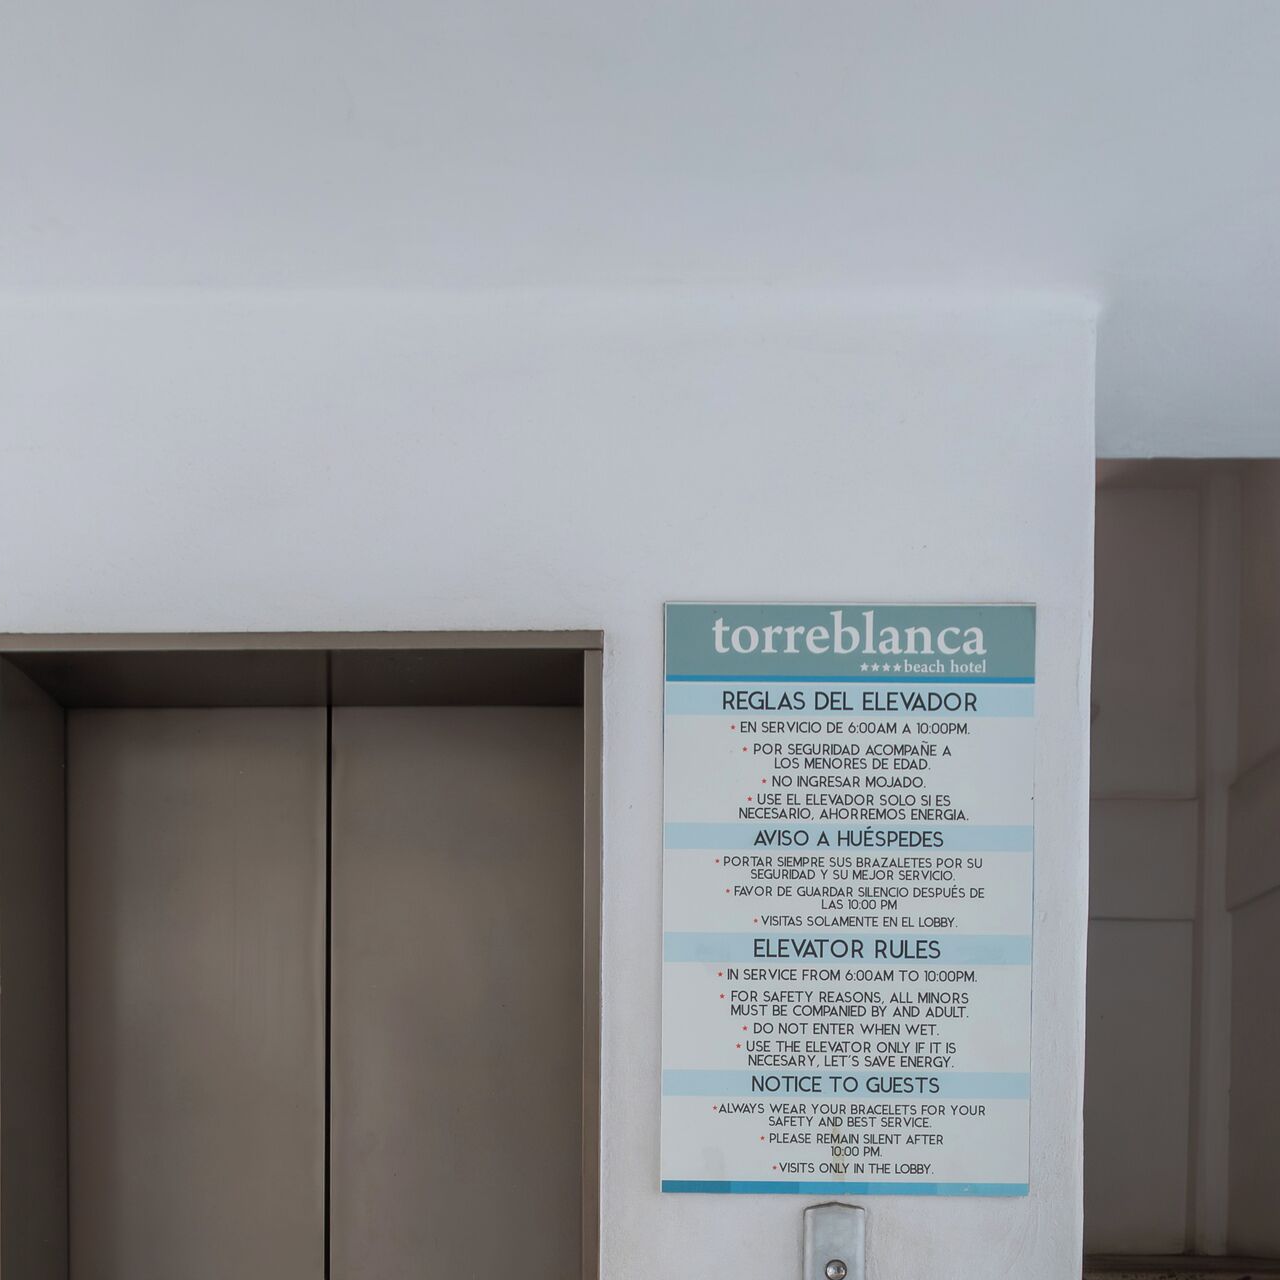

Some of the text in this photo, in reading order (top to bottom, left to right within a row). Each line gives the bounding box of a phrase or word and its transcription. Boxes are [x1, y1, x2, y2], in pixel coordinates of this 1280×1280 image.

[712, 611, 986, 654] torreblanca
[905, 660, 985, 672] beach hotel
[723, 691, 977, 711] REGLAS DEL ELEVADOR
[741, 721, 970, 734] EN SERVICIO DE 6:00AM A 10:00PM.
[754, 741, 951, 756] POR SEGURIDAD ACOMPAÑE A
[775, 757, 930, 770] LOS MENORES DE EDAD.
[772, 775, 926, 788] NO INGRESAR MOJADO.
[757, 793, 951, 806] USE EL ELEVADOR SOLO SI ES
[739, 807, 968, 820] NECESARIO, AHORREMOS ENERGIA.
[754, 826, 943, 847] AVISO A HUÉSPEDES
[724, 856, 982, 868] PORTAR SIEMPRE SUS BRAZALETES POR SU
[751, 869, 955, 881] SEGURIDAD Y SU MEJOR SERVICIO.
[734, 885, 984, 898] FAVOR DE GUARDAR SILENCIO DESPUÉS DE
[822, 899, 897, 910] LAS 10:00 PM
[761, 916, 957, 927] VISITAS SOLAMENTE EN EL LOBBY.
[754, 939, 941, 959] ELEVATOR RULES
[727, 968, 977, 982] IN SERVICE FROM 6:00AM TO 10:00PM.
[731, 990, 969, 1004] FOR SAFETY REASONS, ALL MINORS
[731, 1004, 968, 1018] MUST BE COMPANIED BY AND ADULT.
[754, 1023, 939, 1035] DO NOT ENTER WHEN WET.
[746, 1040, 956, 1054] USE THE ELEVATOR ONLY IF IT IS
[748, 1054, 954, 1068] NECESARY, LET'S SAVE ENERGY.
[752, 1076, 939, 1093] NOTICE TO GUESTS
[719, 1103, 985, 1116] ALWAYS WEAR YOUR BRACELETS FOR YOUR
[769, 1116, 932, 1128] SAFETY AND BEST SERVICE.
[770, 1133, 943, 1145] PLEASE REMAIN SILENT AFTER
[831, 1146, 882, 1157] 10:00 PM.
[779, 1162, 933, 1174] VISITS ONLY IN THE LOBBY.
